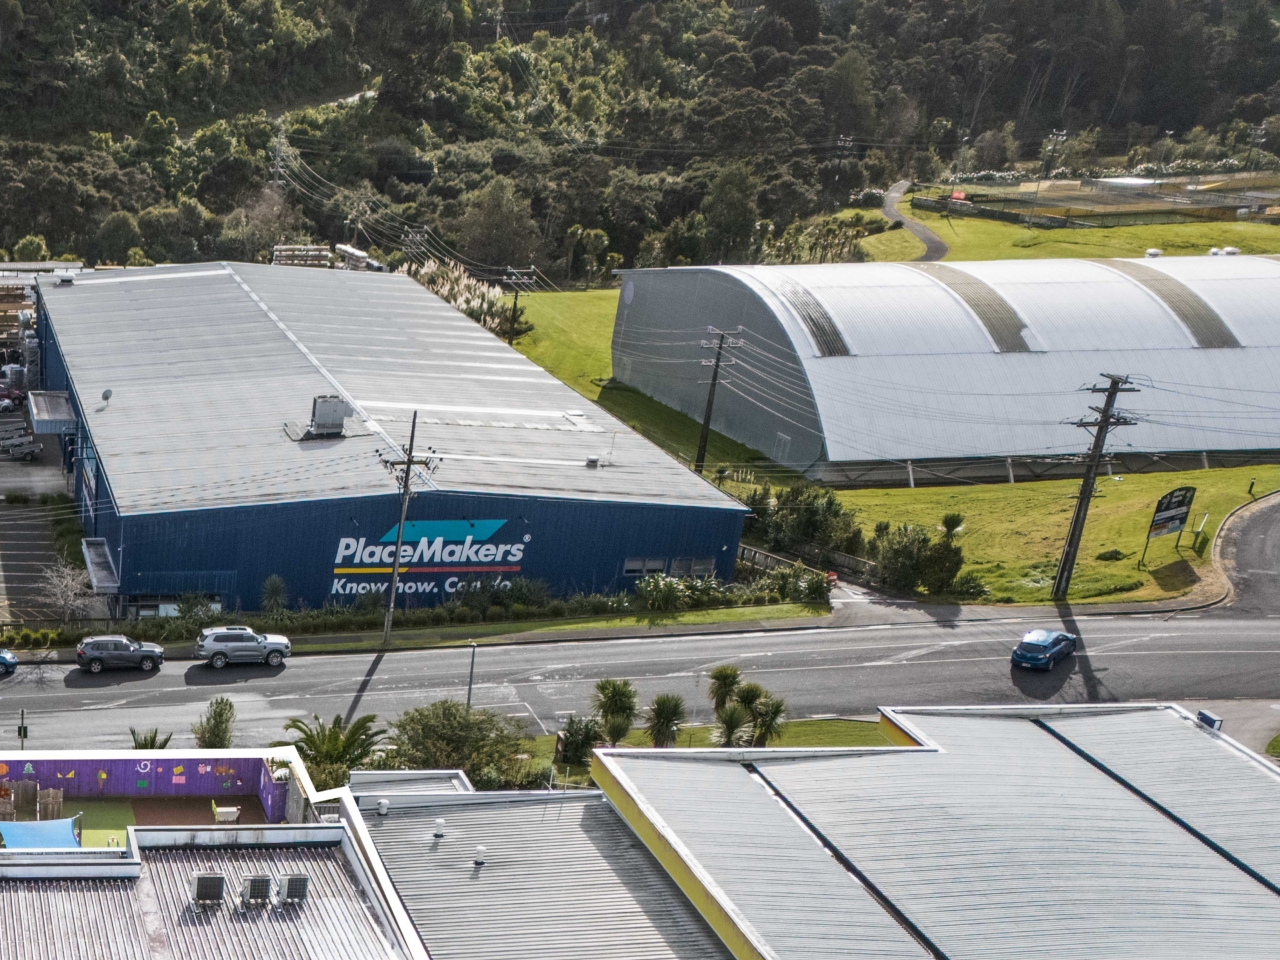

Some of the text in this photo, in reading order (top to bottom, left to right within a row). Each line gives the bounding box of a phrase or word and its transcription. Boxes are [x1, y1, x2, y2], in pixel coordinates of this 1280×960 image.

[334, 535, 525, 564] PlaceMakers
[331, 578, 389, 595] Know
[395, 576, 439, 594] how.
